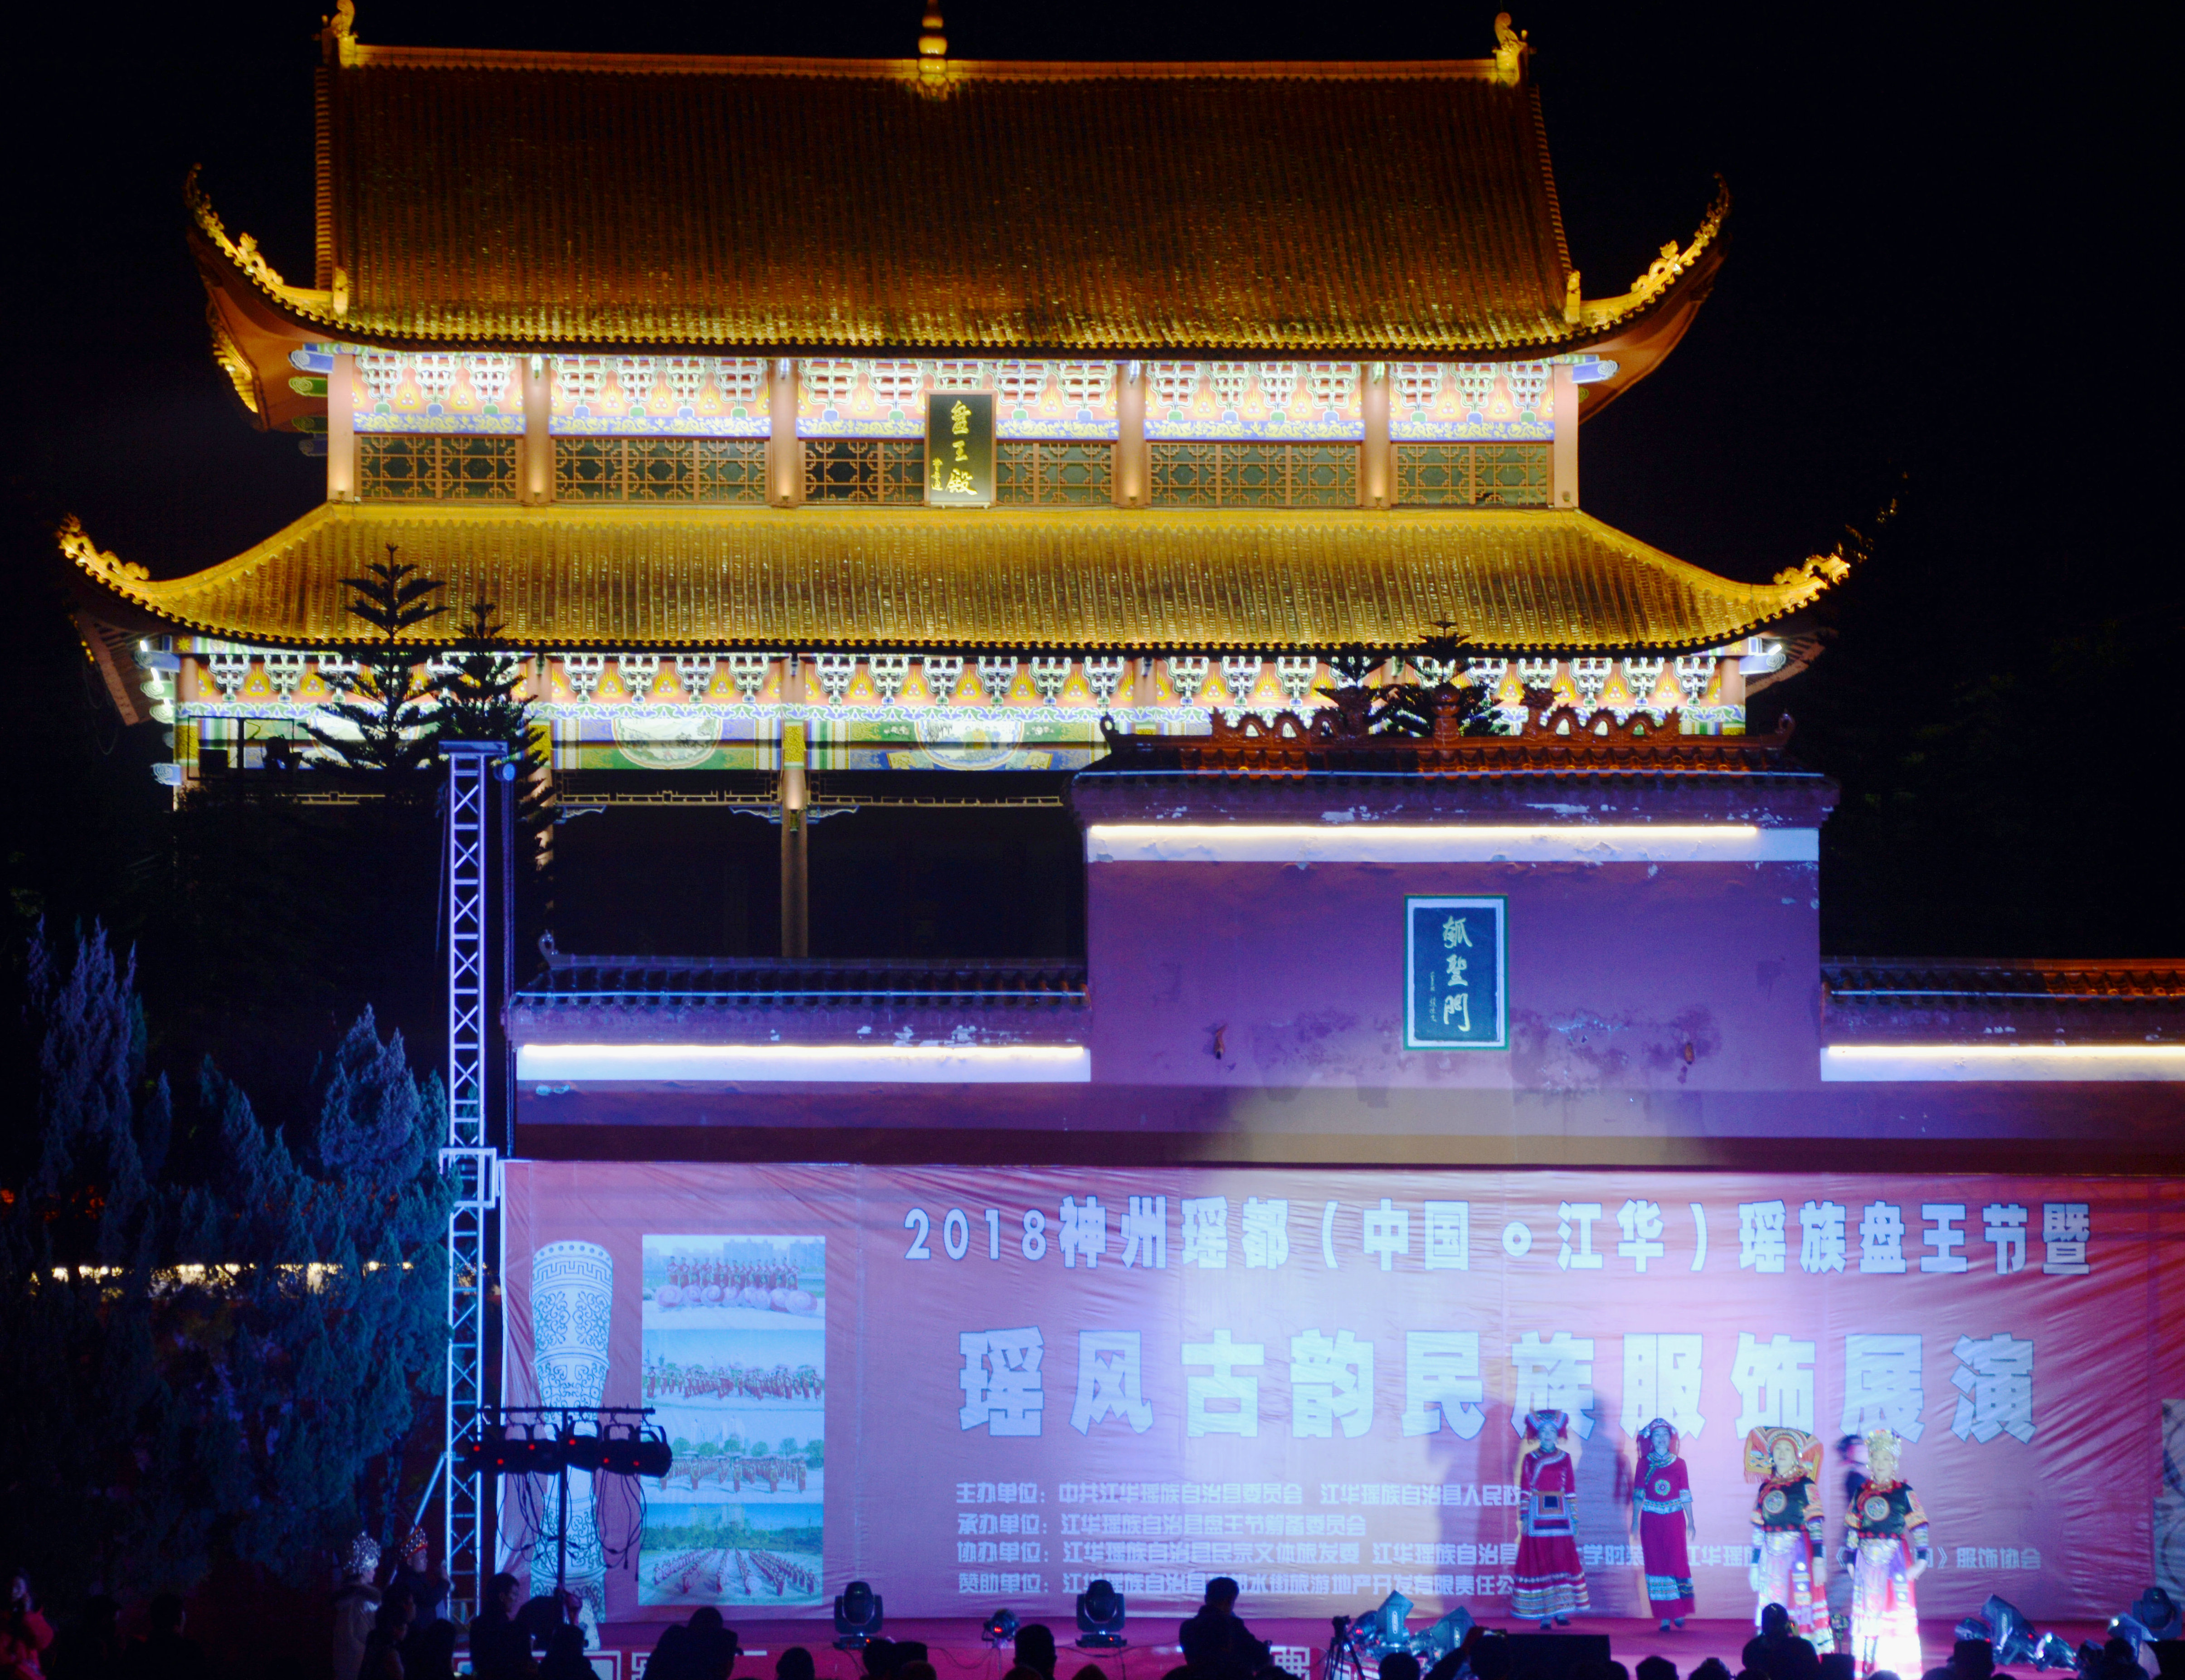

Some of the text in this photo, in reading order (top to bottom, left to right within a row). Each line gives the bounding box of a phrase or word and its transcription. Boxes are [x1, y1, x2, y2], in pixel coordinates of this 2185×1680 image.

[958, 1326, 2037, 1445] 瑶风古韵民族服饰展演
[1059, 1483, 1303, 1504] 中共江华瑶族自治县委员会
